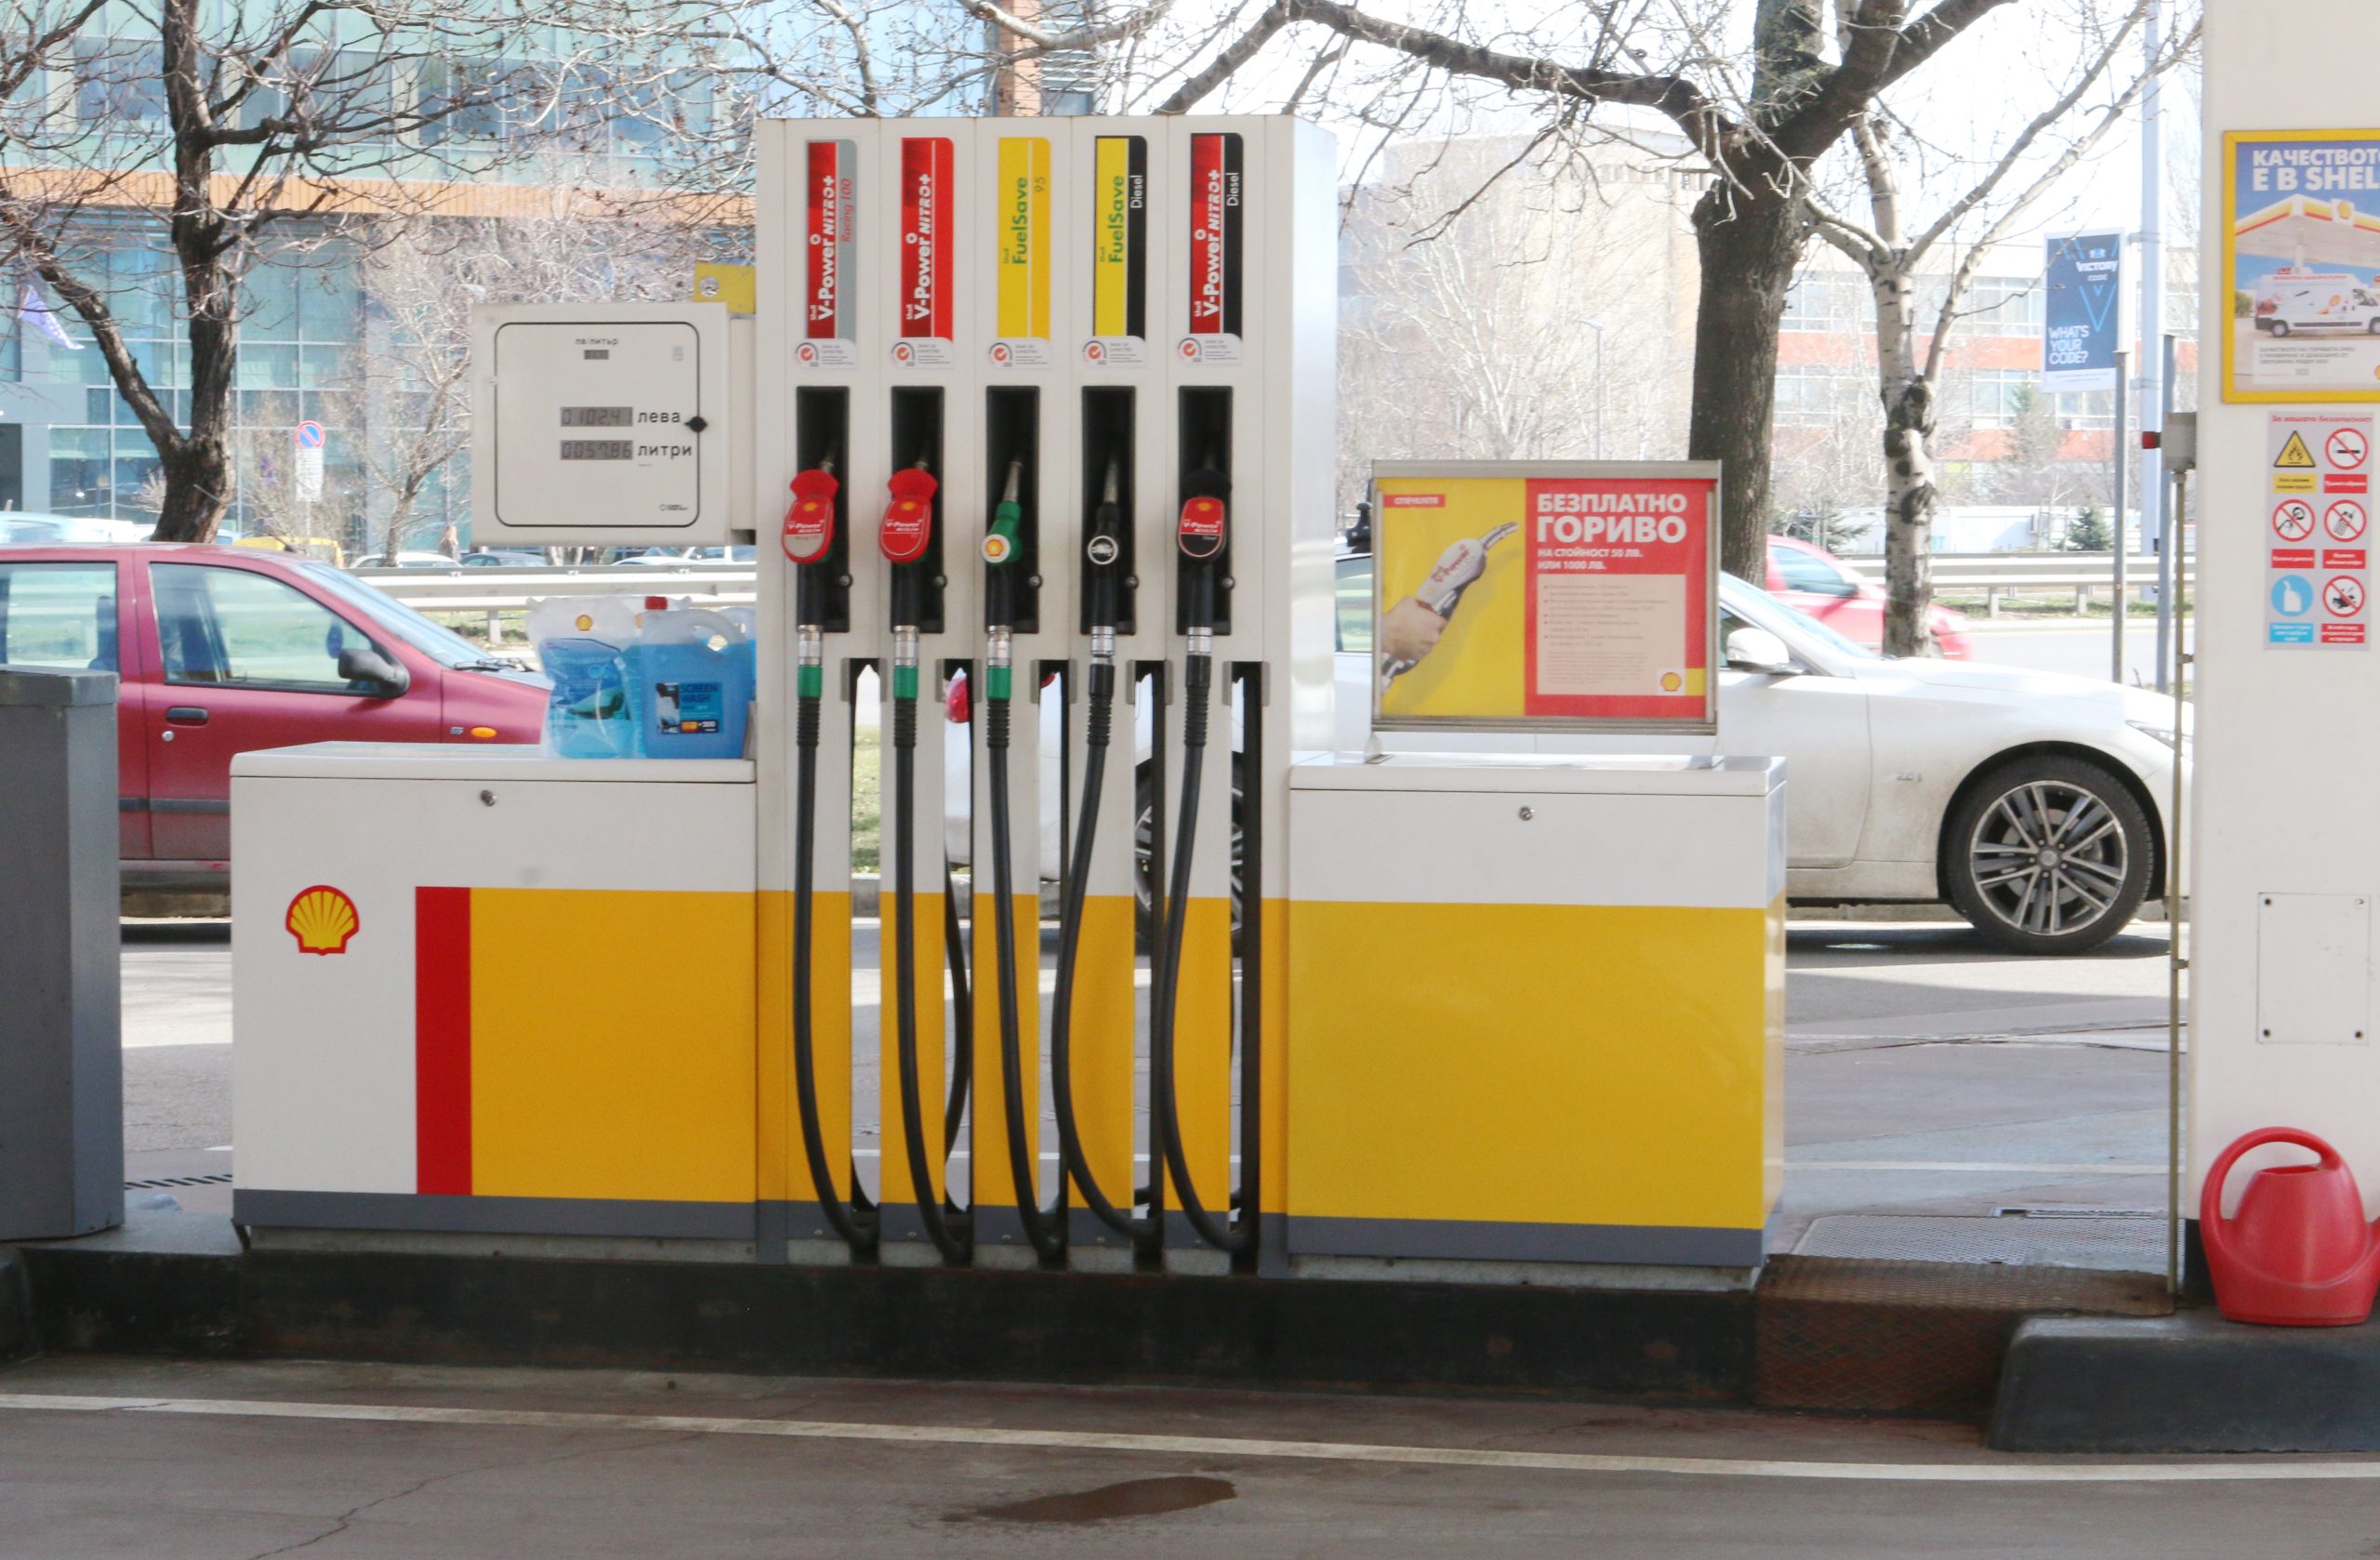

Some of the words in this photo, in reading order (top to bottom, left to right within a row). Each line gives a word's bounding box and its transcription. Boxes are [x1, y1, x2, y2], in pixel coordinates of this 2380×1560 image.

[2253, 148, 2380, 166] КАЧЕСТВОТ
[840, 178, 853, 200] 100
[1034, 177, 1047, 193] 95
[1129, 175, 1144, 208] Diesel
[1225, 172, 1240, 206] Diesel
[840, 205, 855, 243] Racing
[1012, 177, 1028, 264] FuelSave
[1107, 175, 1124, 263] FuelSave
[817, 238, 835, 321] V-Power
[914, 237, 932, 321] V-Power
[1203, 233, 1221, 317] V-Power
[2049, 350, 2089, 365] CODE?
[2050, 338, 2083, 352] YOUR
[637, 411, 681, 423] лева
[637, 444, 693, 460] литри
[1537, 493, 1687, 513] БЕЗПЛАТНО
[1537, 515, 1687, 544] ГОРИВО
[1538, 549, 1554, 558] НА
[1554, 547, 1610, 558] СТОЙНОСТ
